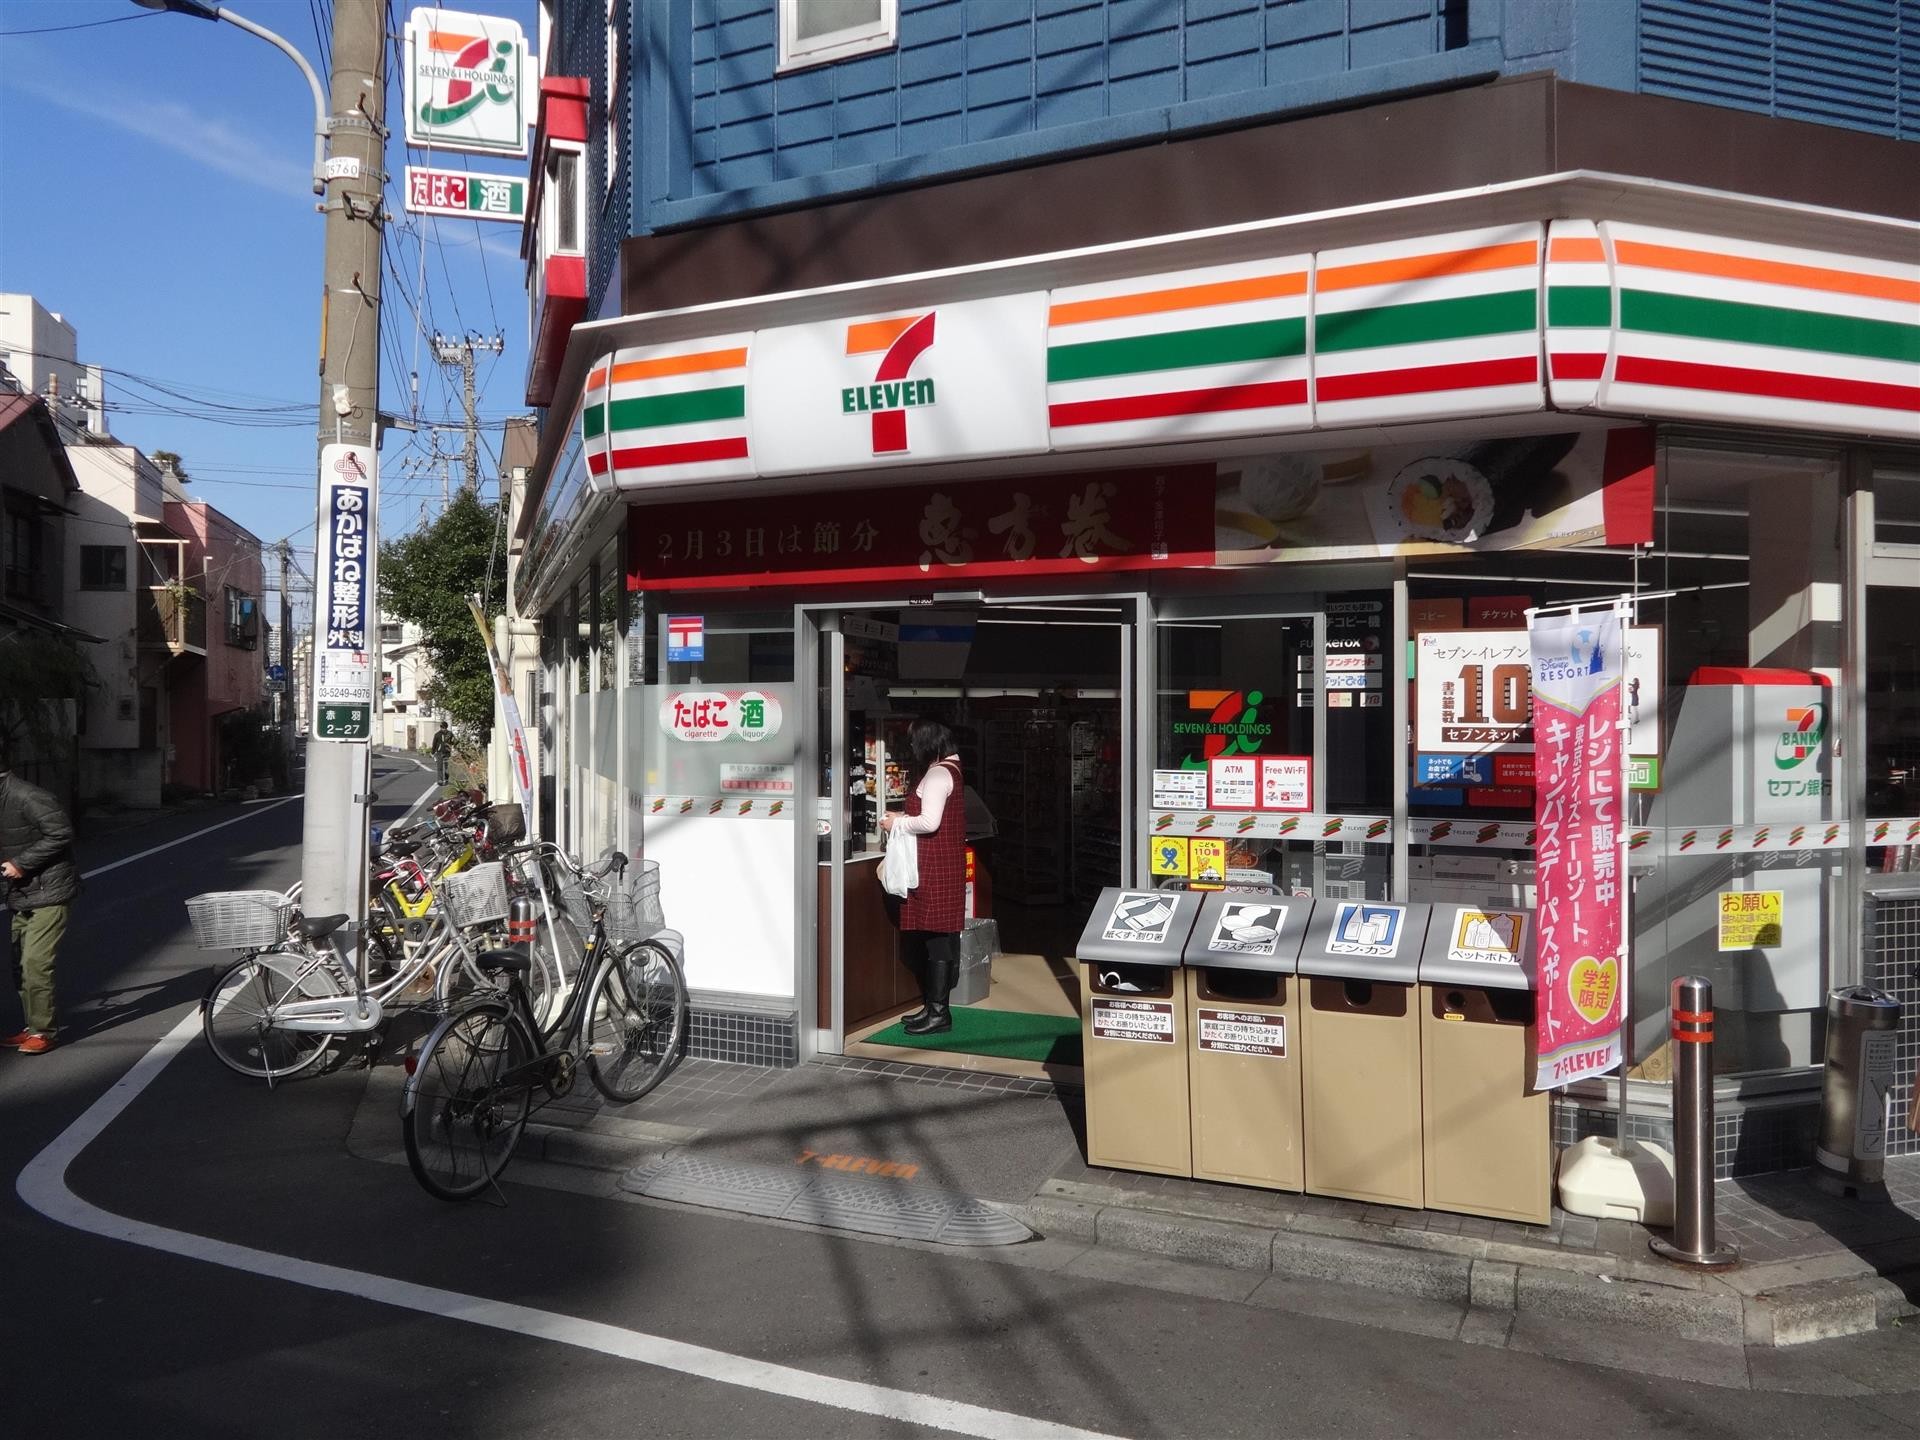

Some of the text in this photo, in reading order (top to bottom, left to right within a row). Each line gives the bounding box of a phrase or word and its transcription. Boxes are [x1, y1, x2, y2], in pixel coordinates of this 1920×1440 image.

[464, 68, 515, 84] HOLDINGS
[413, 174, 511, 212] たばこ 酒
[1300, 615, 1381, 628] マチコピー機
[1481, 609, 1517, 620] チケット
[1540, 666, 1588, 682] RESORT
[319, 687, 371, 699] 03-5249-4976
[674, 698, 765, 729] たばこ 酒
[326, 724, 360, 735] 2-27
[684, 729, 765, 738] cigarette liquor
[1218, 723, 1272, 736] HOLDINGS
[1446, 728, 1520, 742] セブンネット
[1781, 731, 1817, 746] BANK
[1224, 765, 1243, 774] ATM
[1264, 766, 1306, 775] Free Wi-Fi
[1767, 778, 1833, 797] セブン銀行
[1588, 713, 1616, 907] レジにて販売中
[1538, 717, 1571, 1044] キャンパスデーパスポート
[1722, 894, 1779, 912] お願い
[1210, 940, 1274, 954] プラスチック類
[1451, 950, 1521, 963] ペットボトル
[1582, 969, 1611, 990] 学生
[1578, 989, 1609, 1010] 限定
